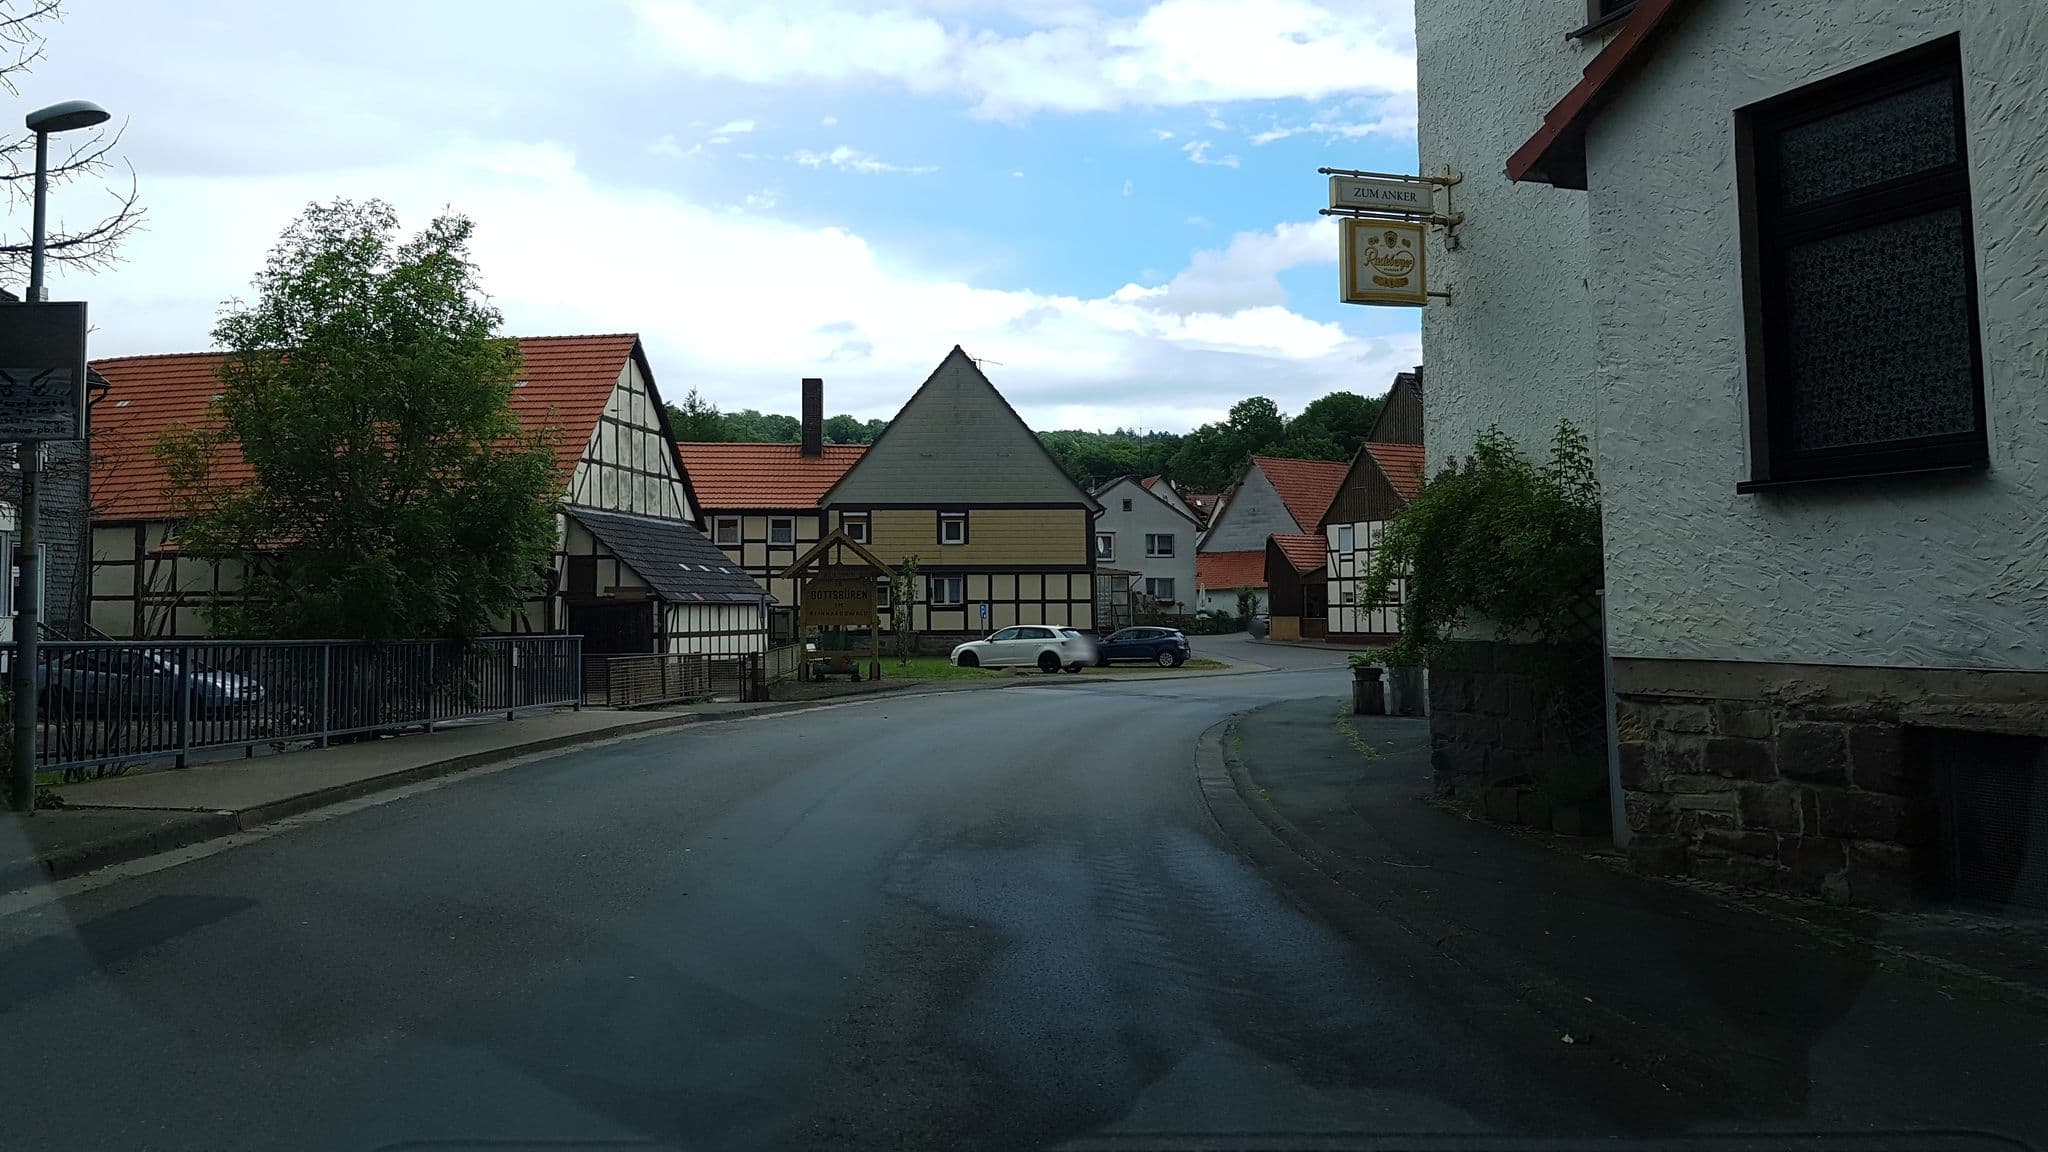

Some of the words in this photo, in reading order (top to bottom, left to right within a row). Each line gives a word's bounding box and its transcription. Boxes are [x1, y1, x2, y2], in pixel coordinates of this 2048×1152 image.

[1354, 187, 1379, 199] ZUM
[1381, 190, 1417, 202] ANKER
[811, 587, 868, 600] GOTTSBÜREN
